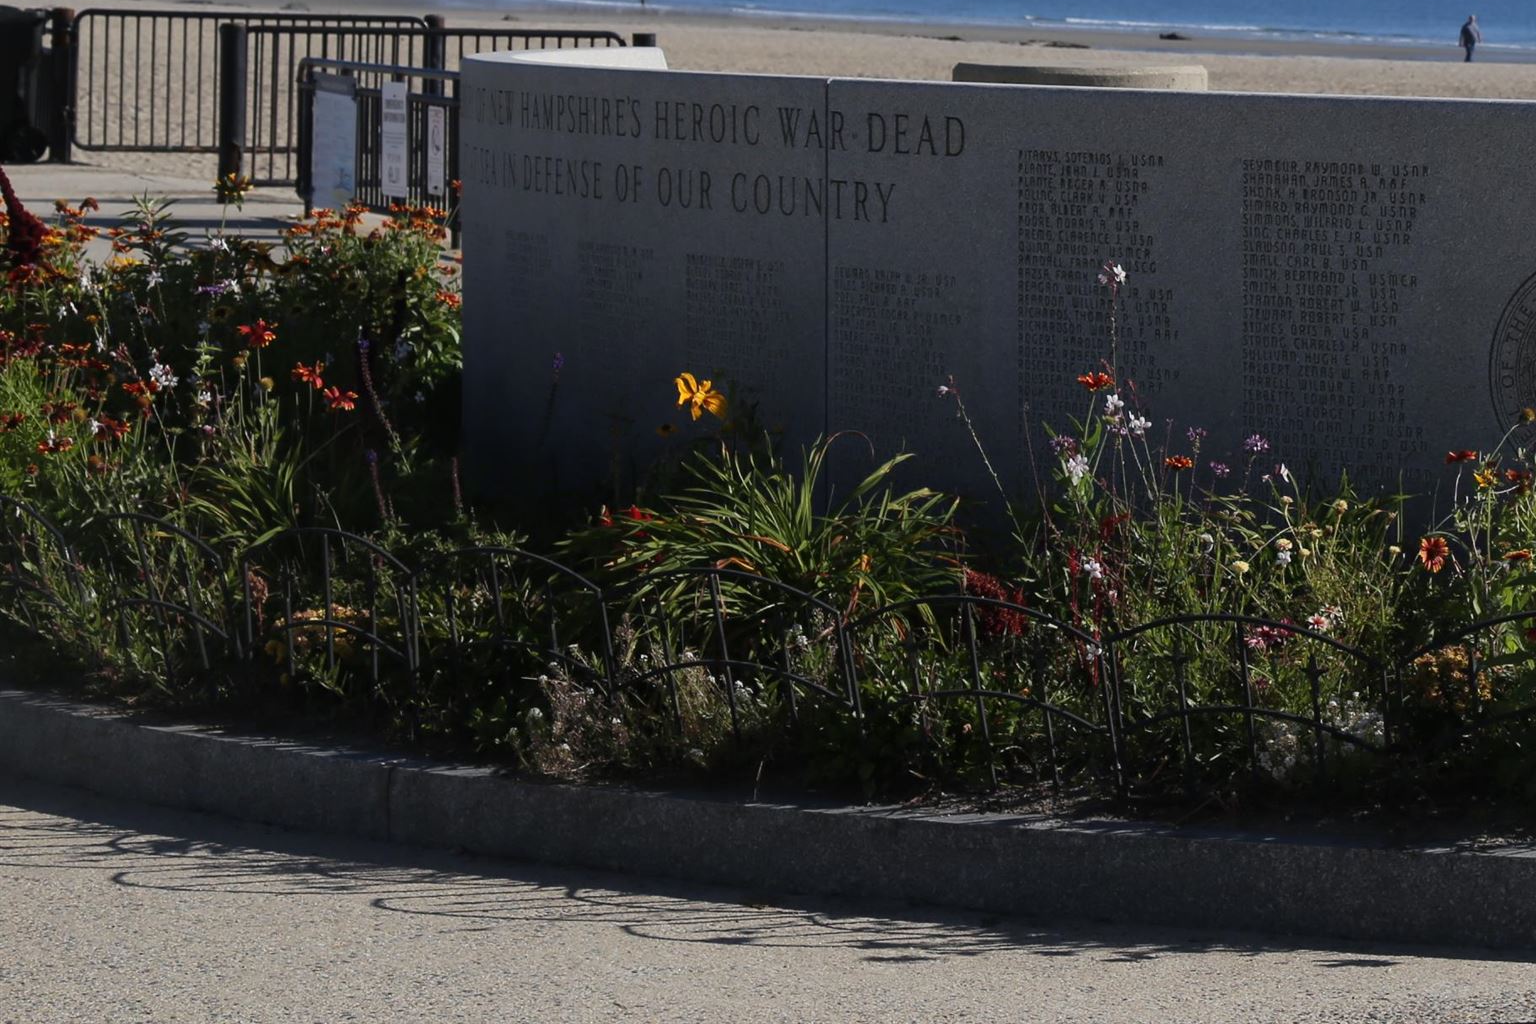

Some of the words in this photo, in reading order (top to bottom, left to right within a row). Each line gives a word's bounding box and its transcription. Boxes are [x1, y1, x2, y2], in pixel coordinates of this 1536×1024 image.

[520, 91, 642, 140] HAMPSHIRE'S
[655, 100, 761, 146] HEROIC
[777, 106, 848, 151] WAR
[867, 112, 966, 157] DEAD
[1305, 161, 1364, 175] RAYMOND
[502, 150, 517, 189] IN
[522, 154, 604, 200] DEFENSE
[614, 163, 644, 204] OF
[657, 166, 714, 211] OUR
[731, 171, 896, 224] COUNTRY
[1313, 175, 1353, 189] JAMES
[1389, 192, 1426, 205] USNR
[1294, 201, 1354, 216] RAYMOND
[1375, 219, 1413, 233] USNR
[1058, 230, 1111, 245] CLARENCE
[1130, 234, 1154, 247] USN
[1276, 228, 1328, 242] CHARLES
[1373, 232, 1411, 246] USNR
[1303, 243, 1333, 256] PAUL
[1356, 246, 1383, 259] USN
[1286, 256, 1317, 269] CARL
[1341, 258, 1368, 272] USN
[1284, 269, 1346, 284] BERTRAND
[1295, 283, 1339, 297] STUART
[1369, 287, 1397, 300] USN
[1299, 297, 1345, 312] ROBERT
[1371, 301, 1399, 315] USN
[1300, 310, 1345, 325] ROBERT
[1369, 315, 1397, 328] USN
[1505, 304, 1535, 345] THE
[1342, 327, 1369, 340] USA
[1293, 337, 1346, 352] CHARLES
[1304, 352, 1338, 365] HUGH
[1361, 355, 1390, 369] USN
[1500, 359, 1515, 390] OF
